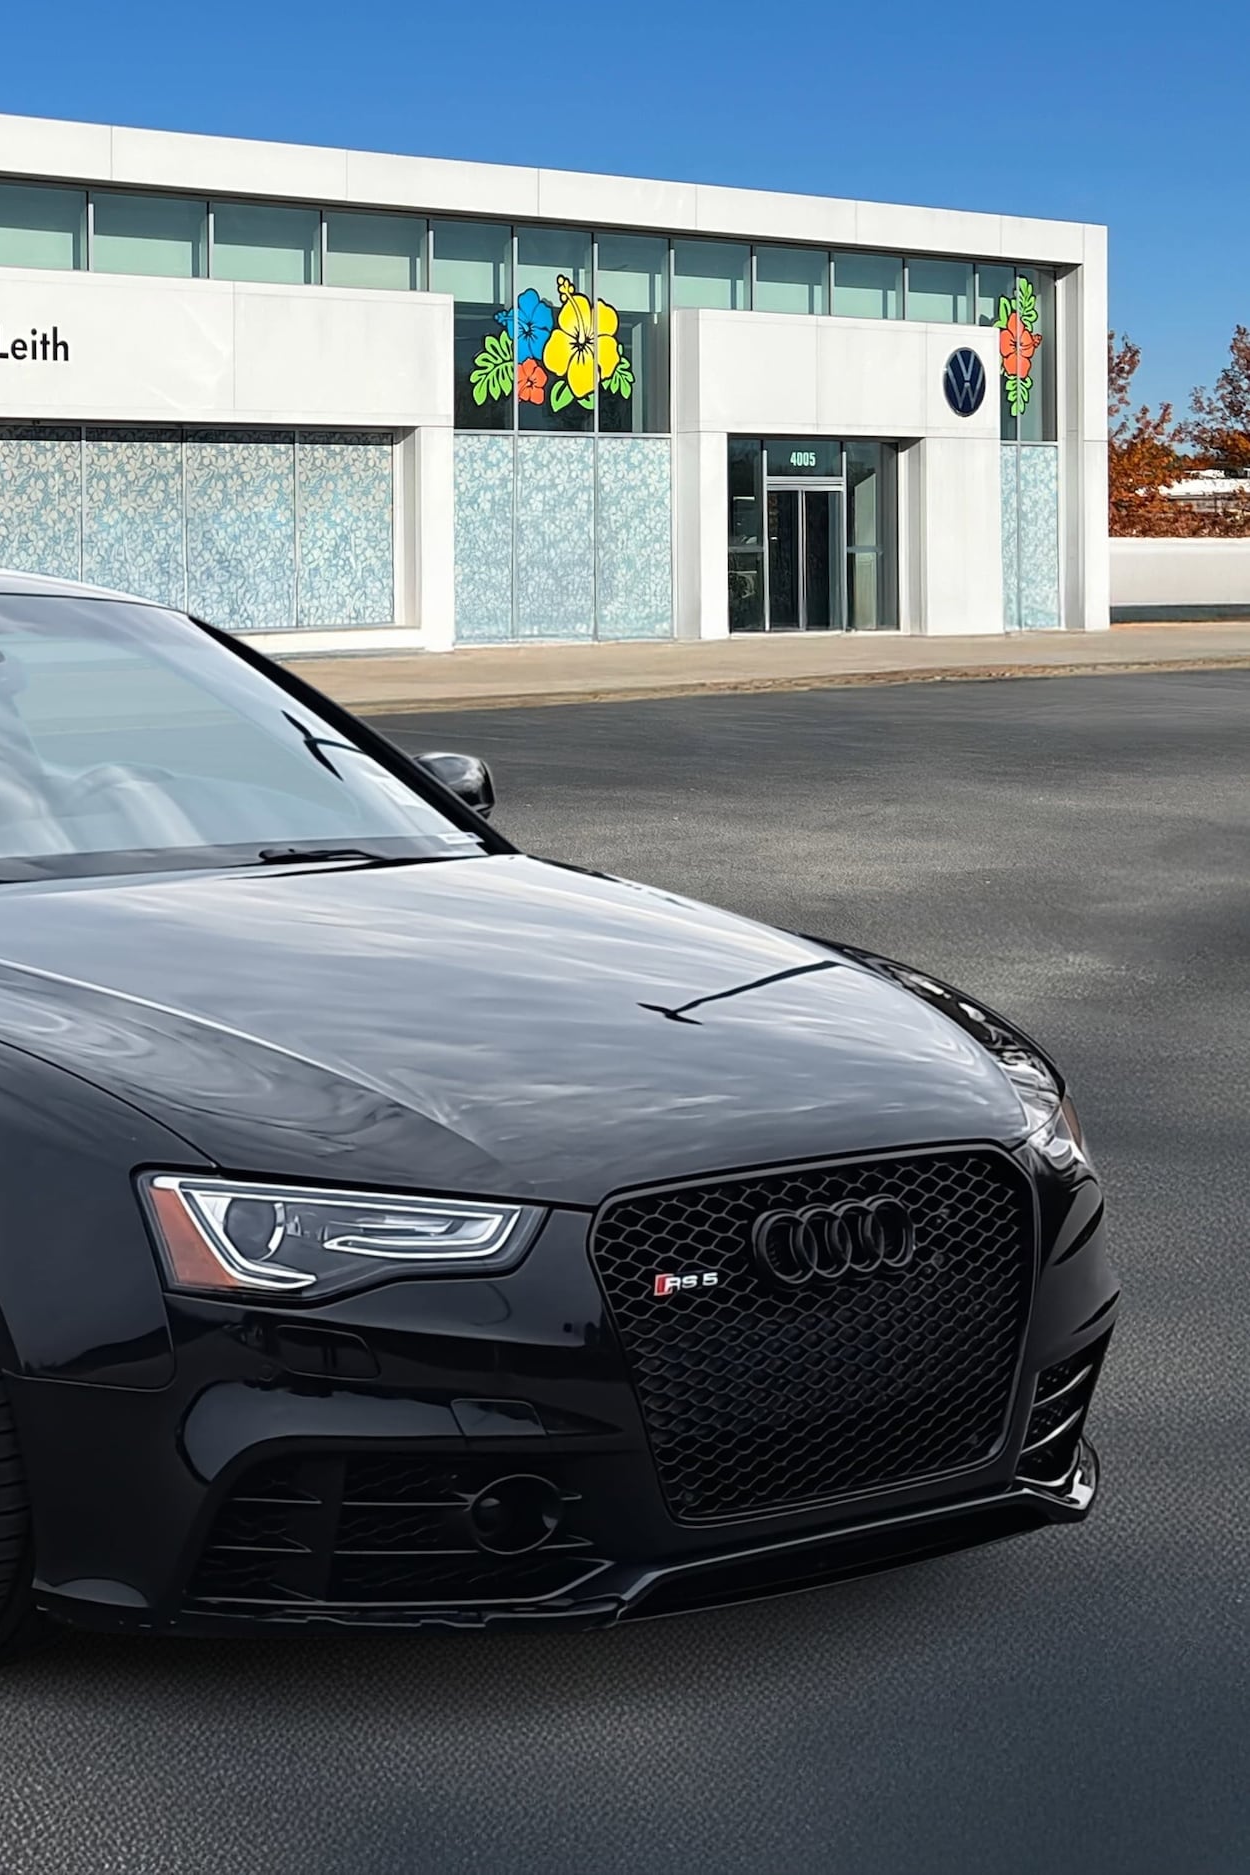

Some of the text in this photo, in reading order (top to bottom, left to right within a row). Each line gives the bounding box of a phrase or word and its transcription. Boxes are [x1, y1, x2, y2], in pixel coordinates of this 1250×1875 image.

[790, 452, 816, 467] 4005
[662, 1272, 719, 1293] RS 5
